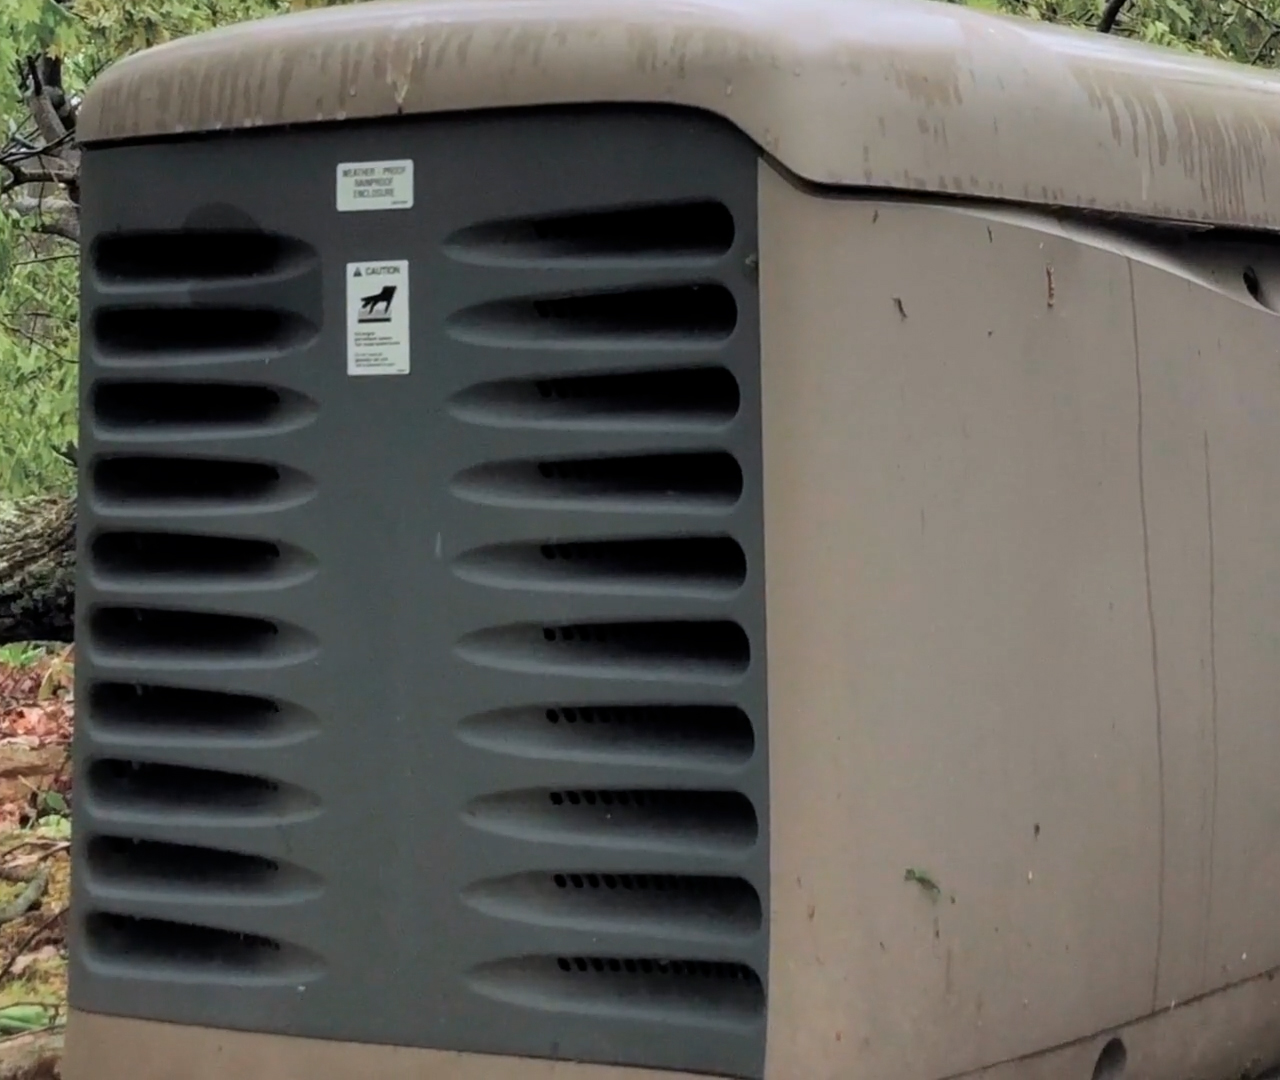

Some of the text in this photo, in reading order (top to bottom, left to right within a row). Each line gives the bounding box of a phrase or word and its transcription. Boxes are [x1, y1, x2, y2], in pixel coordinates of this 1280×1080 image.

[342, 167, 376, 178] WEATHER
[382, 166, 406, 176] PROOF
[353, 188, 395, 199] ENCLOSURE
[365, 266, 401, 276] CAUTION
